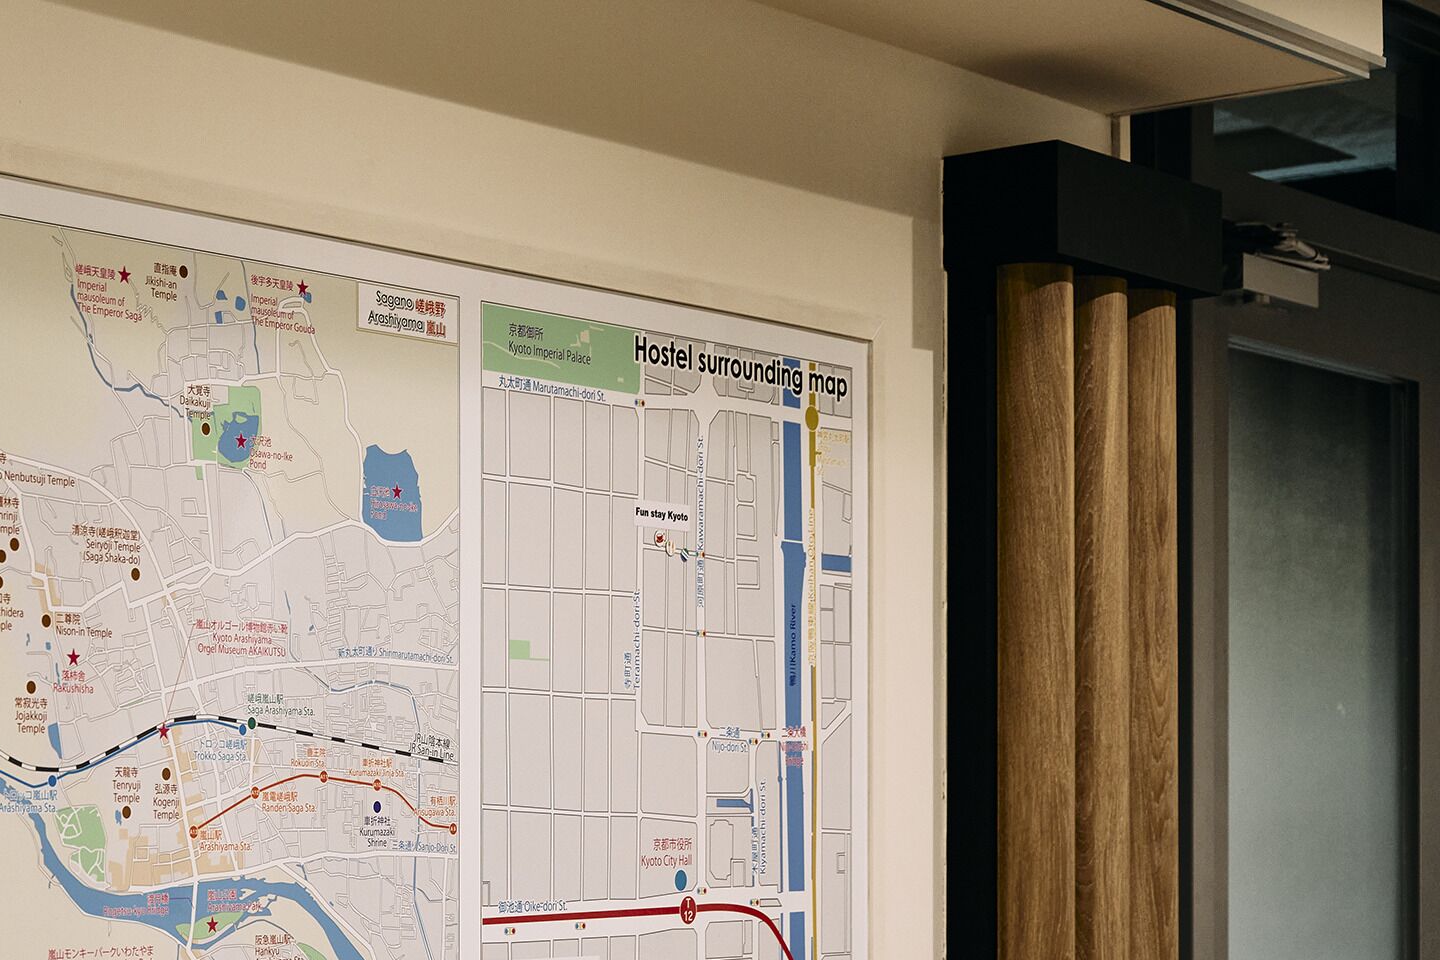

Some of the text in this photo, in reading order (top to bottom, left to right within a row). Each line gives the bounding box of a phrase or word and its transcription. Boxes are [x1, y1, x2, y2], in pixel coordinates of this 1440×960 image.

[75, 263, 115, 280] 嵯峨天皇陵
[77, 278, 107, 292] Imperial
[145, 276, 177, 289] Jikishi-an
[251, 275, 294, 292] 後宇多天皇陵
[77, 290, 125, 307] mausoleum of
[151, 288, 177, 301] Temple
[251, 294, 278, 307] Imperial
[376, 291, 445, 318] Sagano 嵯峨野
[78, 302, 142, 322] The Emperor Saga
[252, 306, 295, 320] mausoleum of
[252, 316, 315, 335] The Emperor Gouda
[368, 311, 446, 337] Arashiyama 嵐山
[509, 324, 543, 340] 京都御所
[509, 341, 591, 365] Kyoto Imperial Palace
[635, 335, 847, 401] Hostel surrounding map
[187, 386, 210, 396] 大覚寺
[499, 375, 605, 401] 丸太町通 Marutamachi-dori St.
[180, 395, 211, 409] Daikakuji
[186, 408, 211, 420] Temple
[249, 459, 266, 470] Pond
[4, 471, 46, 484] Nenbutsuji
[48, 475, 75, 487] Temple
[636, 507, 688, 522] Fun stay Kyoto
[86, 540, 141, 553] Seiryoji Temple
[83, 551, 141, 565] (Saga Shaka-do)
[56, 613, 80, 624] 二尊院
[56, 626, 112, 639] Nison-in Temple
[213, 634, 272, 646] Kyoto Arashiyama
[198, 643, 286, 657] Orgel Museum AKAIKUTSU
[53, 684, 94, 694] Rakushisha
[15, 698, 47, 709] 常寂光寺
[15, 710, 47, 723] Jojakkoji
[248, 705, 315, 717] Saga Arashiyama Sta.
[18, 724, 45, 735] Temple
[114, 767, 138, 777] 天龍寺
[113, 780, 141, 792] Tenryuji
[154, 784, 178, 794] 弘源寺
[113, 793, 140, 804] Temple
[153, 798, 179, 809] Kogenji
[153, 809, 179, 820] Temple
[360, 828, 395, 838] Kurumazaki
[368, 837, 387, 847] Shrine
[654, 838, 692, 850] 京都市役所
[641, 855, 692, 868] Kyoto City Hall
[499, 900, 567, 913] 御池通 Oike-dori St.
[686, 899, 691, 908] T
[684, 911, 693, 922] 12
[255, 946, 280, 956] Hankyu
